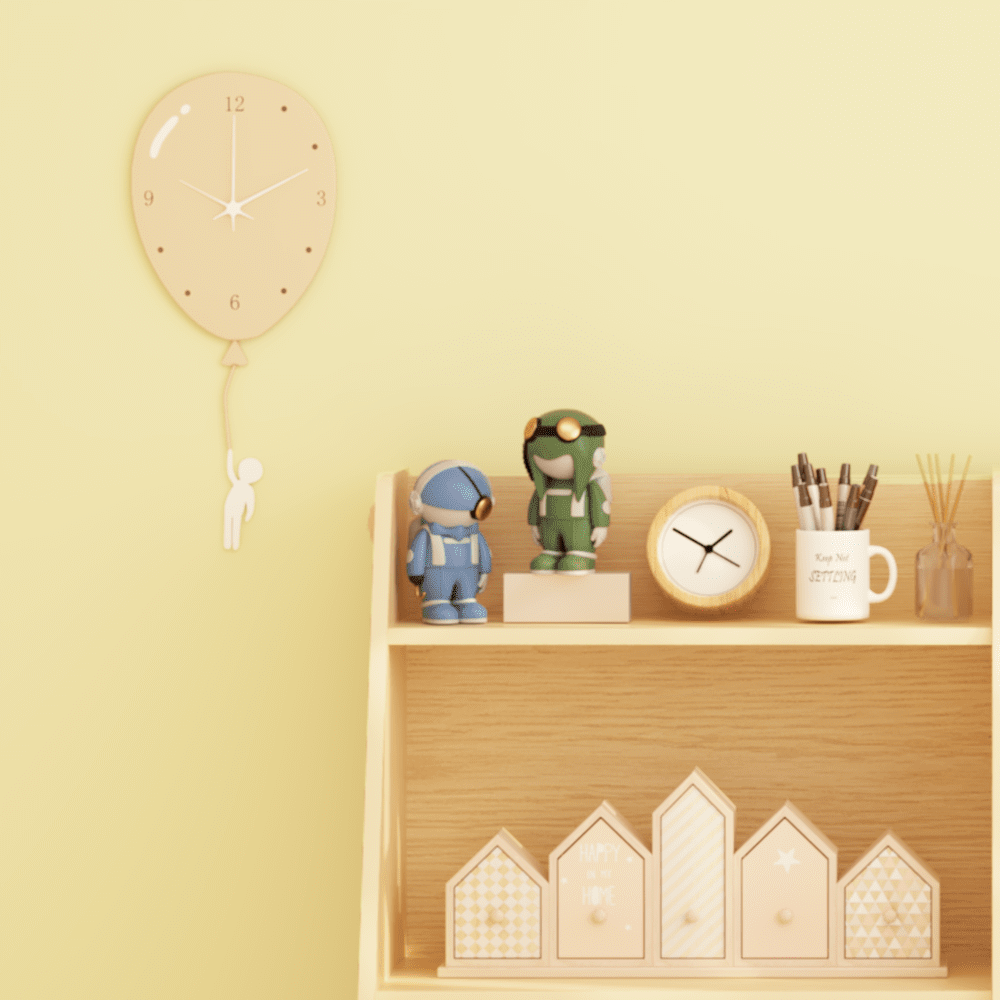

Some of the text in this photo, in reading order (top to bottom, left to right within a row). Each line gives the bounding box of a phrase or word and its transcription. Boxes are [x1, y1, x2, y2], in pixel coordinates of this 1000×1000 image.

[225, 95, 245, 113] 12
[143, 190, 155, 207] 9
[316, 190, 327, 207] 3
[229, 294, 241, 311] 6
[579, 842, 621, 862] HAPPY
